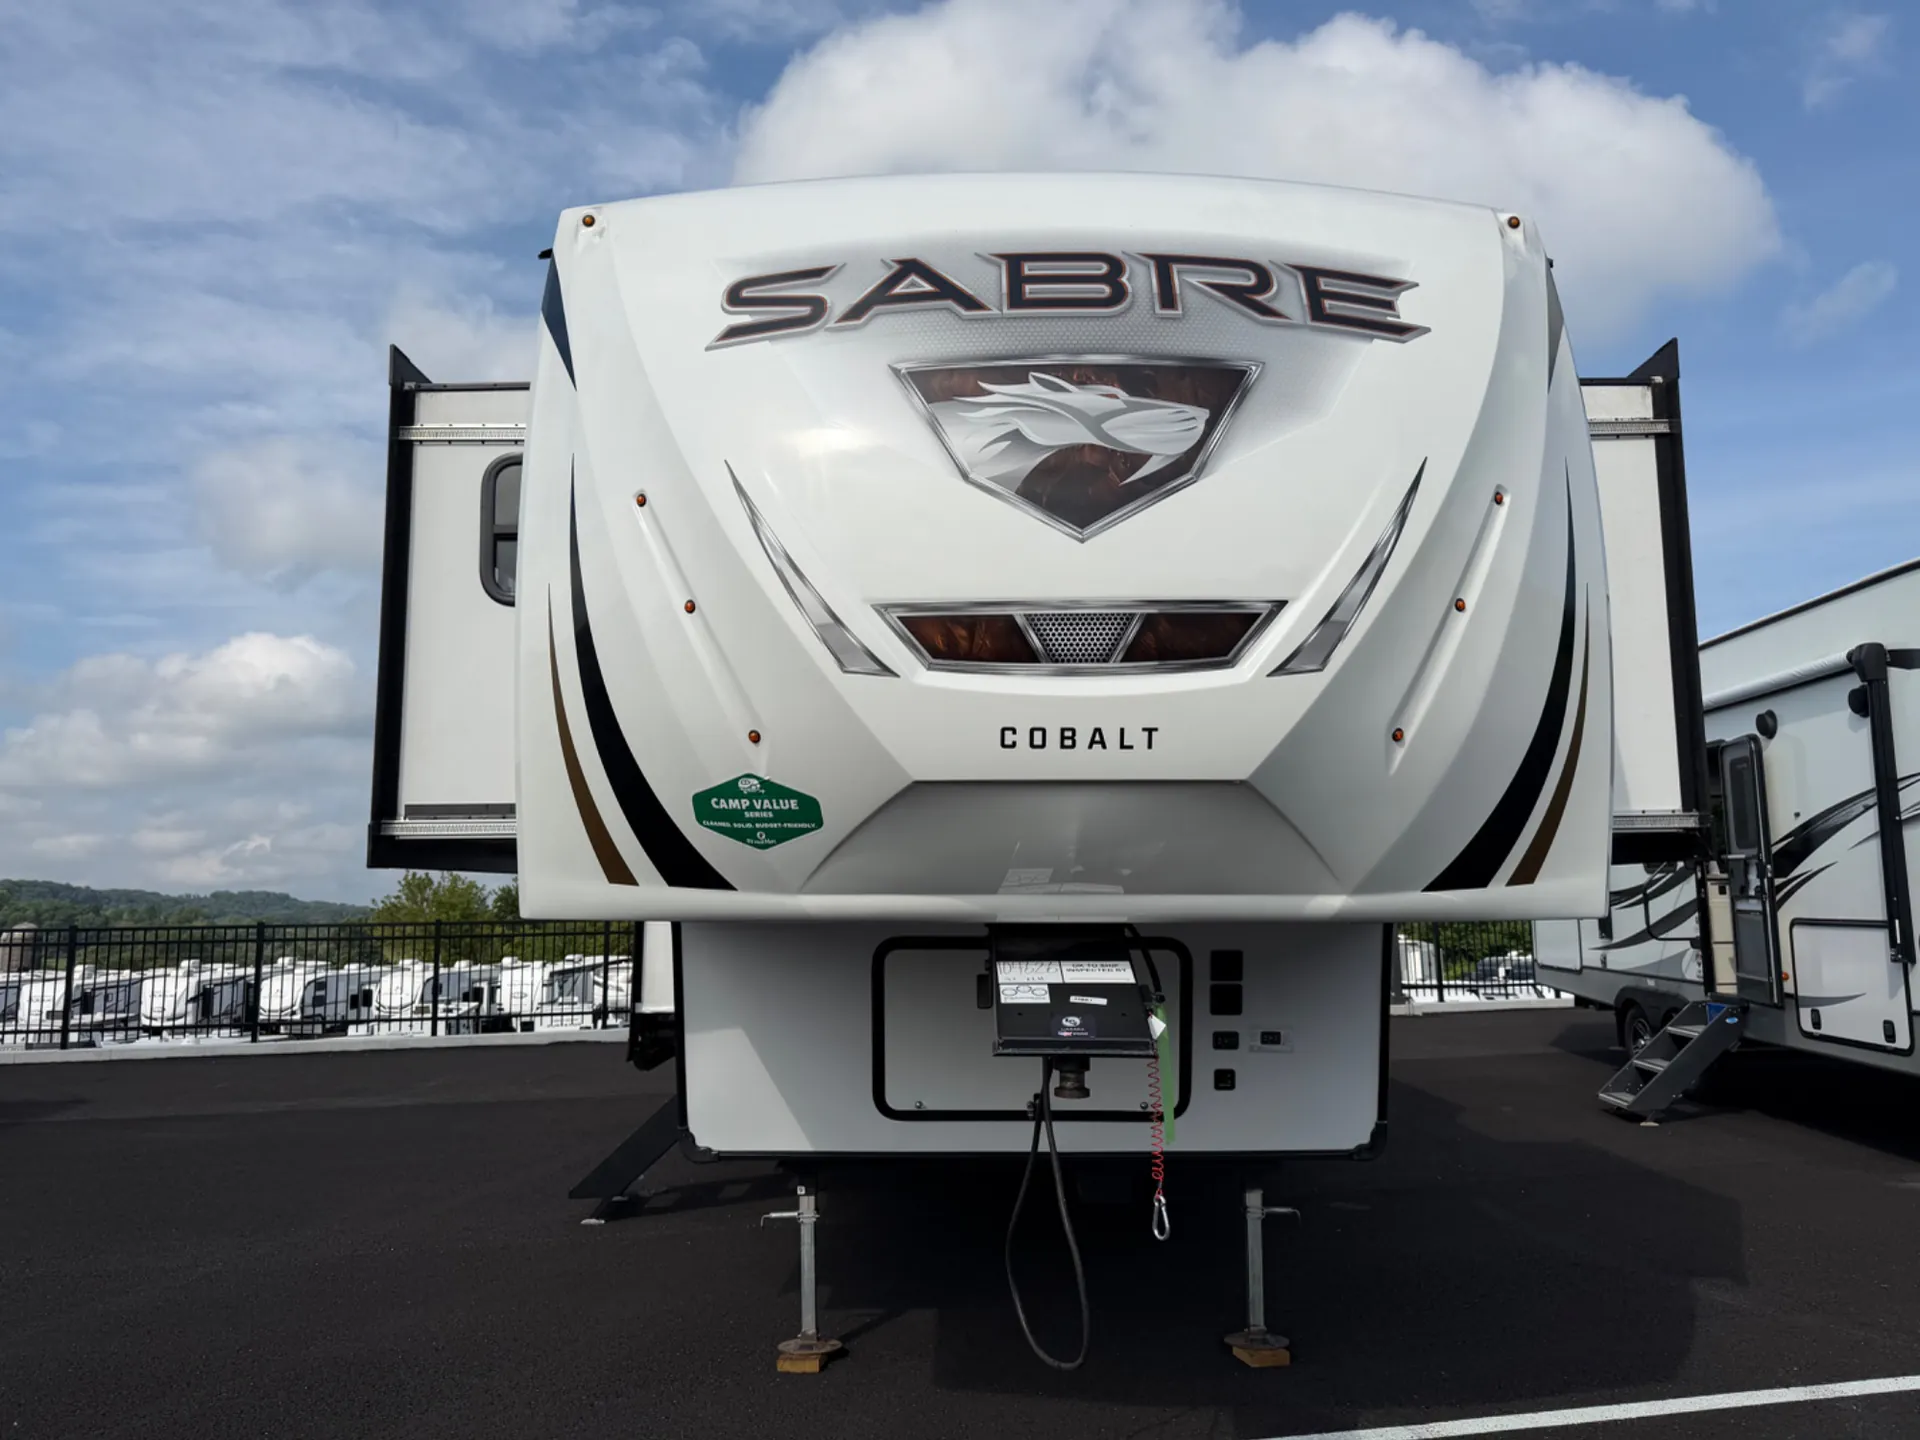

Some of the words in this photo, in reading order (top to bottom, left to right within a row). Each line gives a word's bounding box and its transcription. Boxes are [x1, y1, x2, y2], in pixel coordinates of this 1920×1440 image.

[705, 250, 1431, 351] SABRE
[1000, 726, 1159, 750] COBALT
[711, 798, 750, 810] CAMP
[753, 799, 799, 810] VALUE
